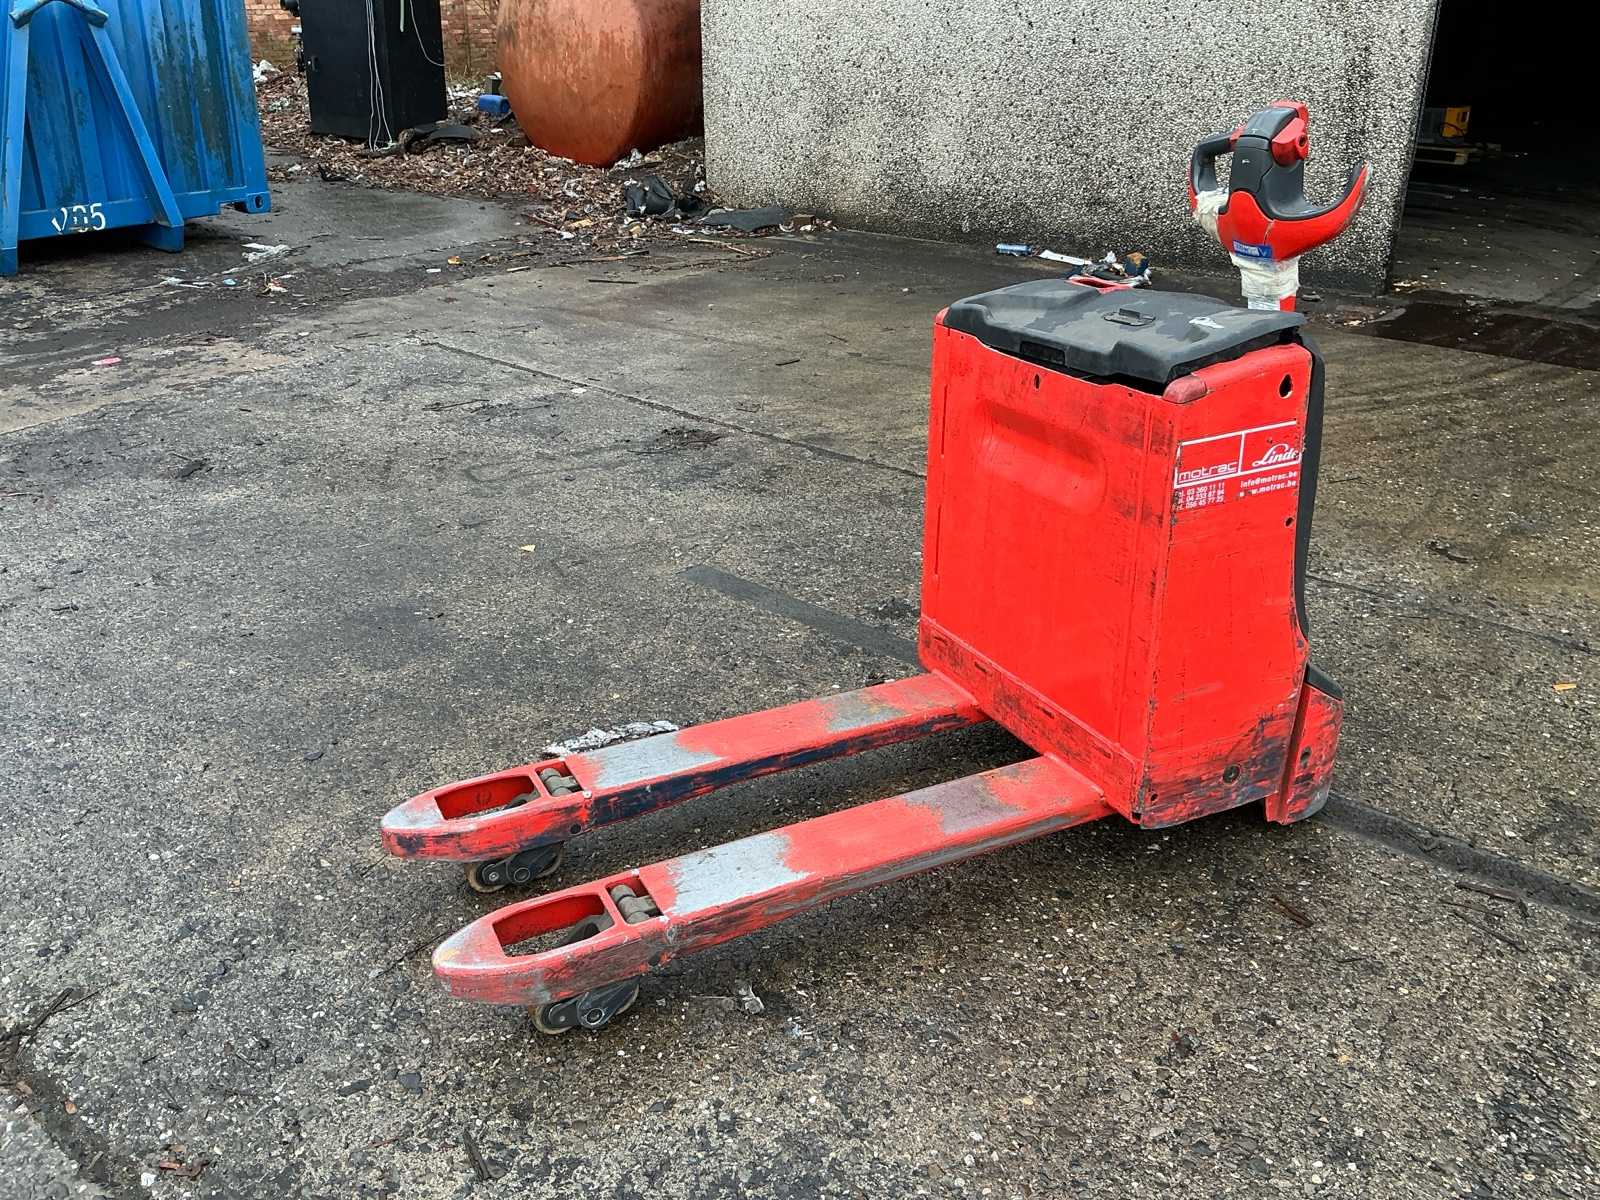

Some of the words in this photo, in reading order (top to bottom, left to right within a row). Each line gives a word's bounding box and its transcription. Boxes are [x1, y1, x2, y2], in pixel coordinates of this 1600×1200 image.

[1179, 461, 1239, 481] motrac
[1240, 471, 1297, 489] info@motrac.be
[1239, 480, 1297, 497] ww.motrac.be
